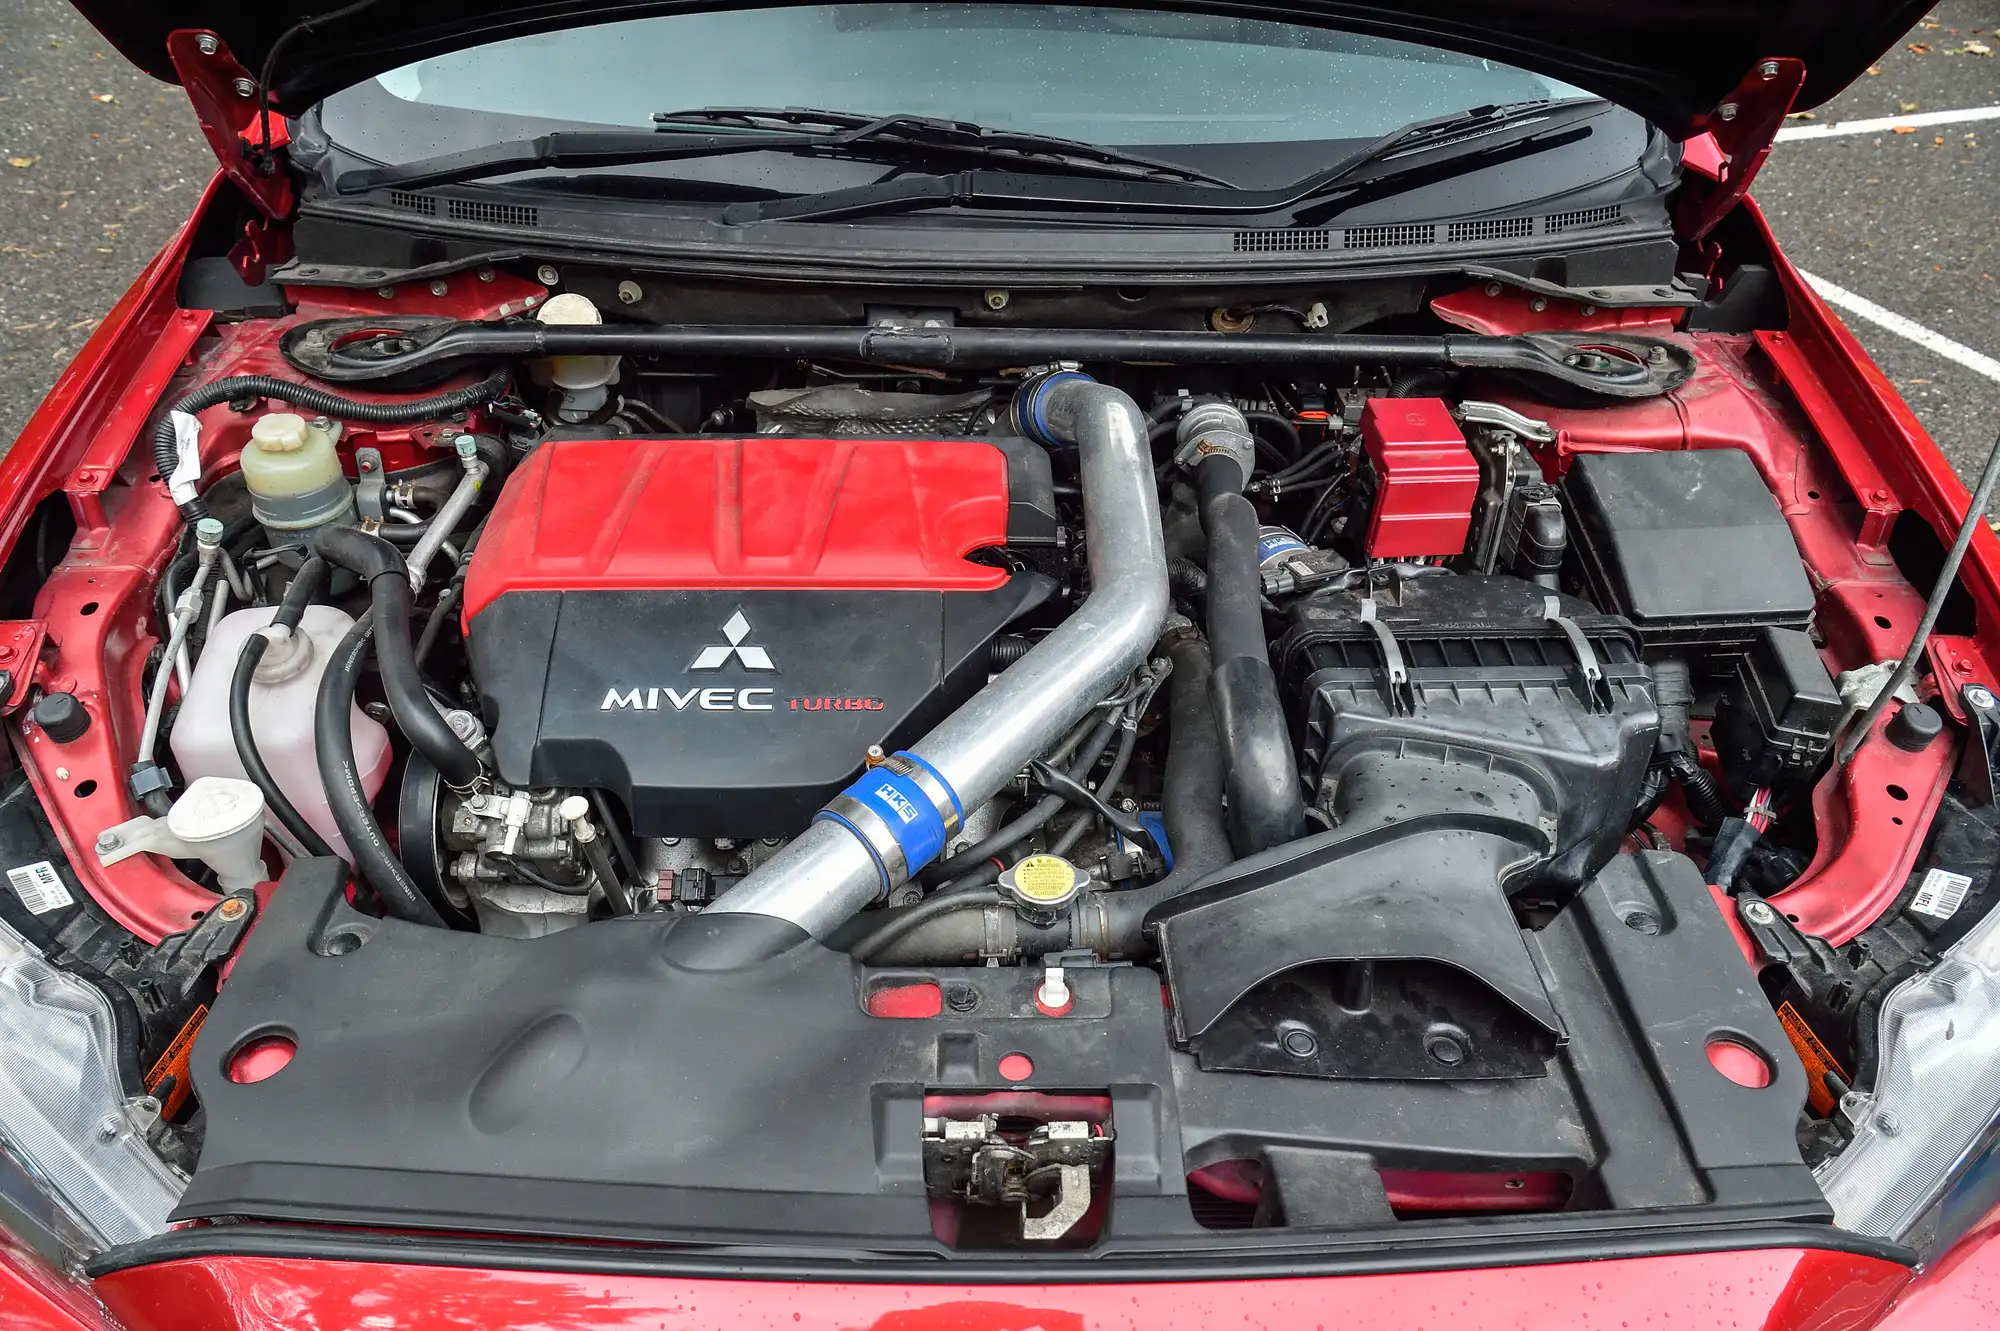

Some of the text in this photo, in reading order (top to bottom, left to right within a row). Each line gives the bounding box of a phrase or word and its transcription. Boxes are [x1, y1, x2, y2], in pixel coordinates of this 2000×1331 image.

[600, 687, 885, 711] MIVEC TURBO
[875, 783, 919, 824] HKS
[35, 866, 55, 884] MFR
[1915, 891, 1933, 907] MFL
